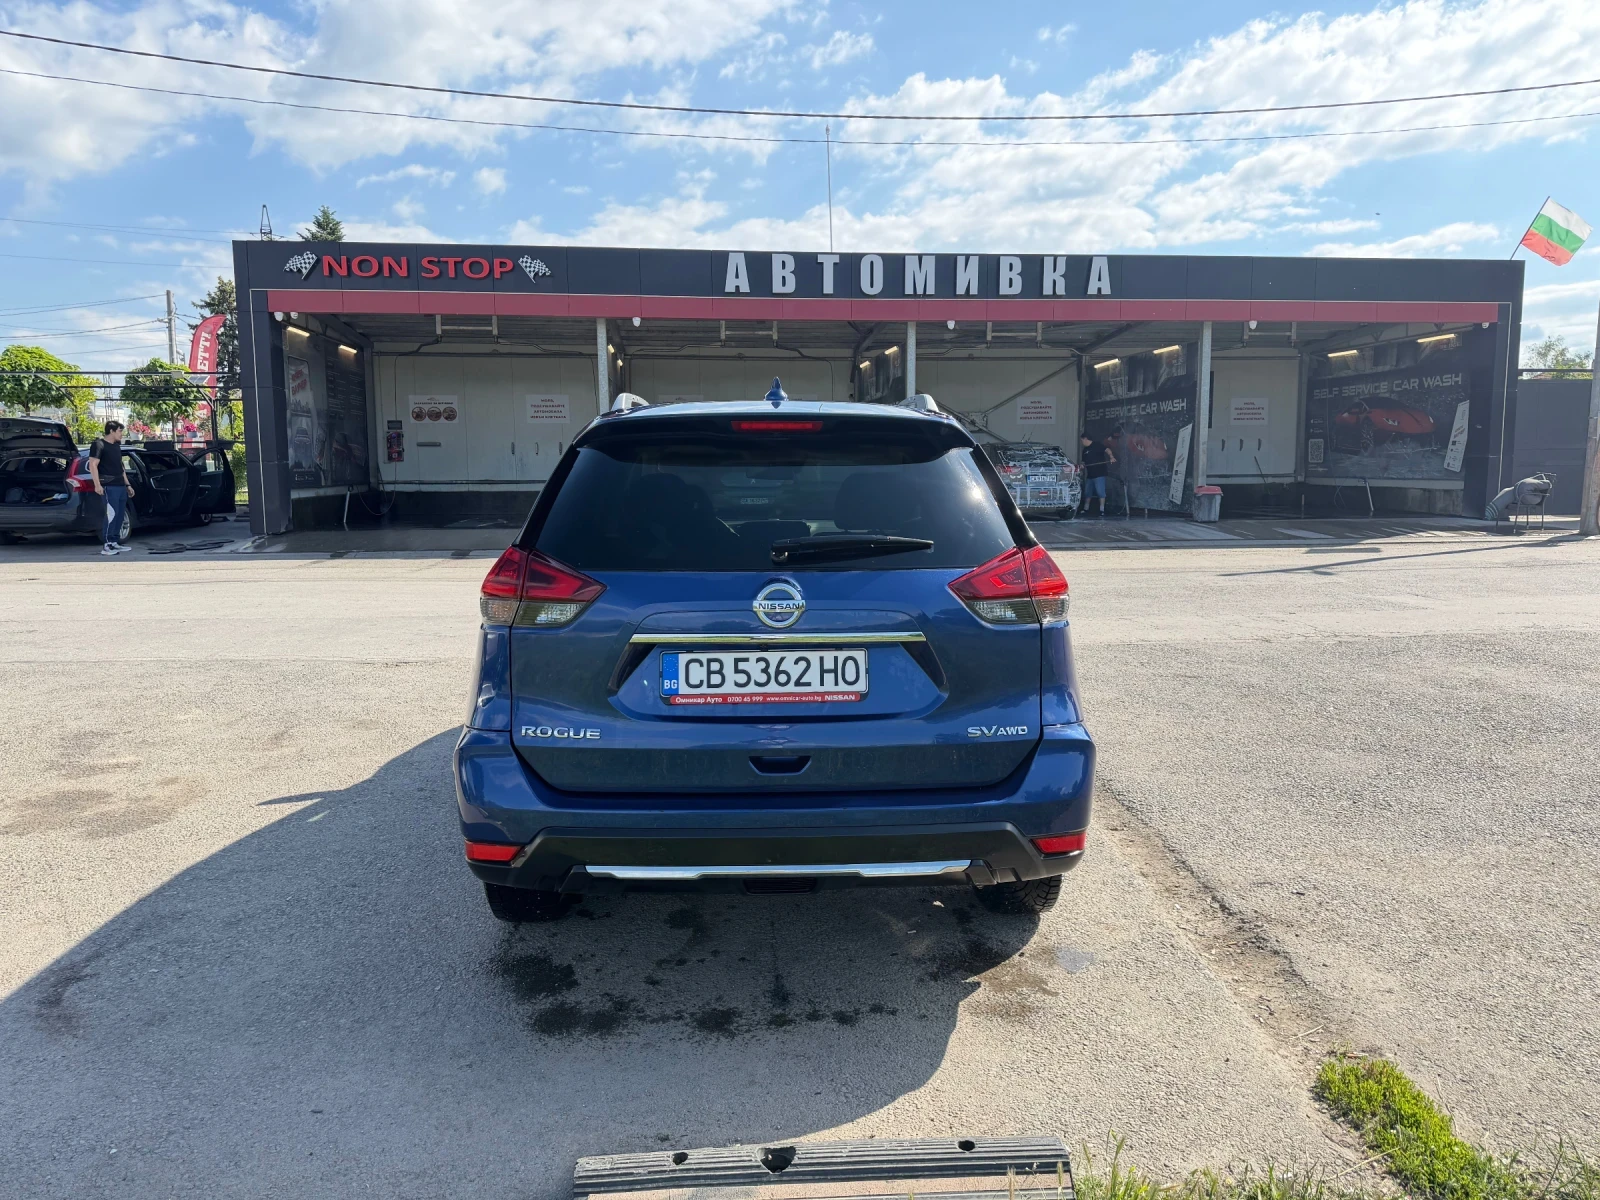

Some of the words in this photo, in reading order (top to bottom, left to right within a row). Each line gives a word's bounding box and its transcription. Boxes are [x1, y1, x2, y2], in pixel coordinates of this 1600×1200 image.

[322, 255, 408, 277] NON
[421, 256, 514, 279] STOP
[724, 252, 1112, 295] АВТОМИВКА
[1313, 387, 1340, 400] SELF
[1342, 381, 1389, 397] SERVICE
[1393, 378, 1419, 392] CAR
[1423, 373, 1462, 388] WASH
[1086, 409, 1104, 420] SELF
[1105, 405, 1137, 419] SERVICE
[1140, 402, 1158, 415] CAR
[1159, 398, 1187, 412] WASH
[758, 602, 802, 610] NISSAN
[663, 679, 678, 690] BG
[706, 696, 722, 704] Ауто
[766, 695, 822, 703] www.omnicar-auto.bg
[521, 725, 601, 739] ROGUE
[967, 725, 997, 737] SV
[997, 726, 1028, 736] AWD
